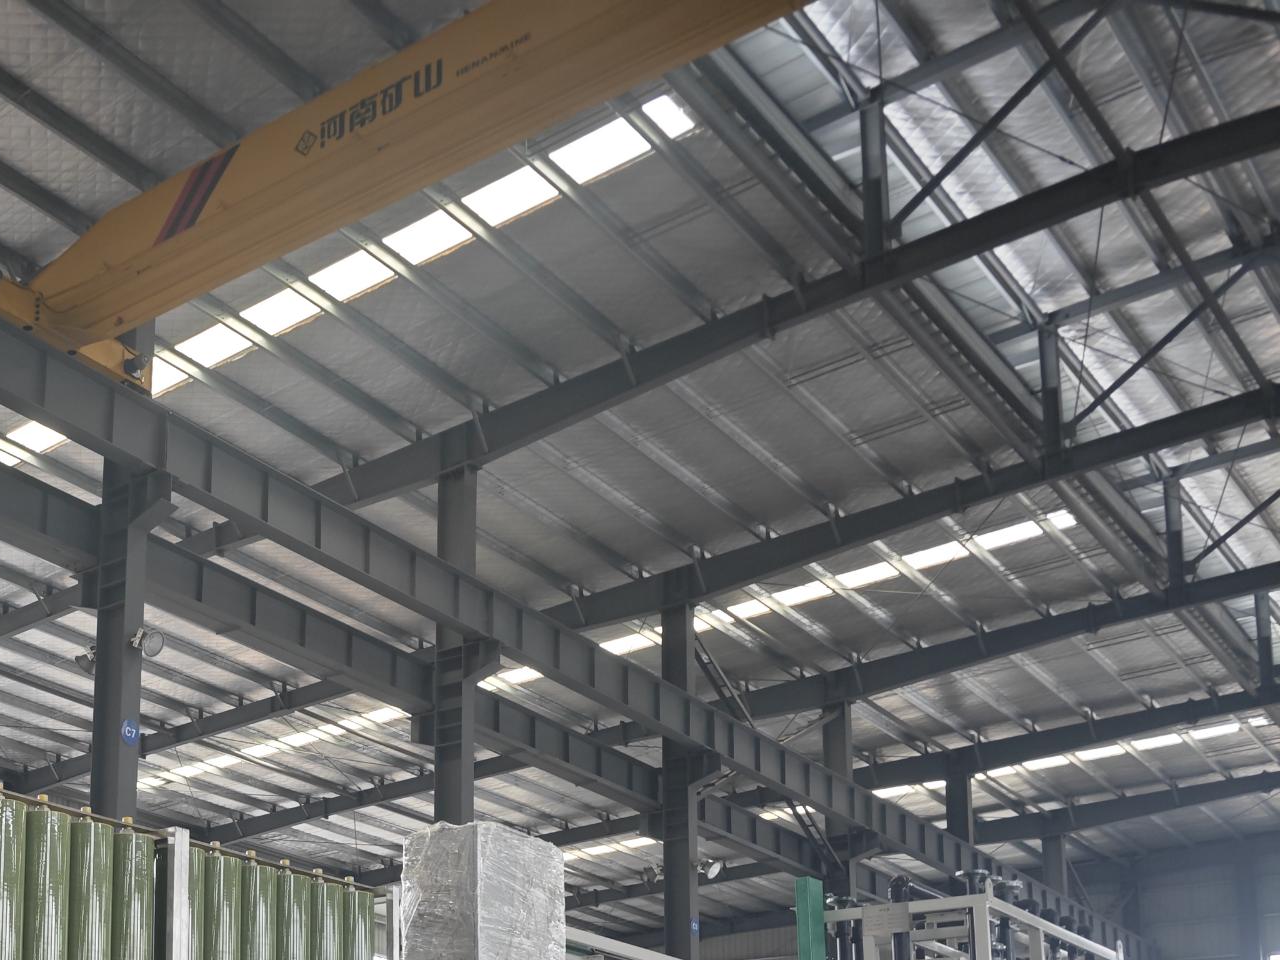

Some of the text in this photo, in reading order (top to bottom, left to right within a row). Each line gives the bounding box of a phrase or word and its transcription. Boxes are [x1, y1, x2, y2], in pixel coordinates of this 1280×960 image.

[319, 57, 444, 149] 河南矿山
[125, 726, 136, 738] C7
